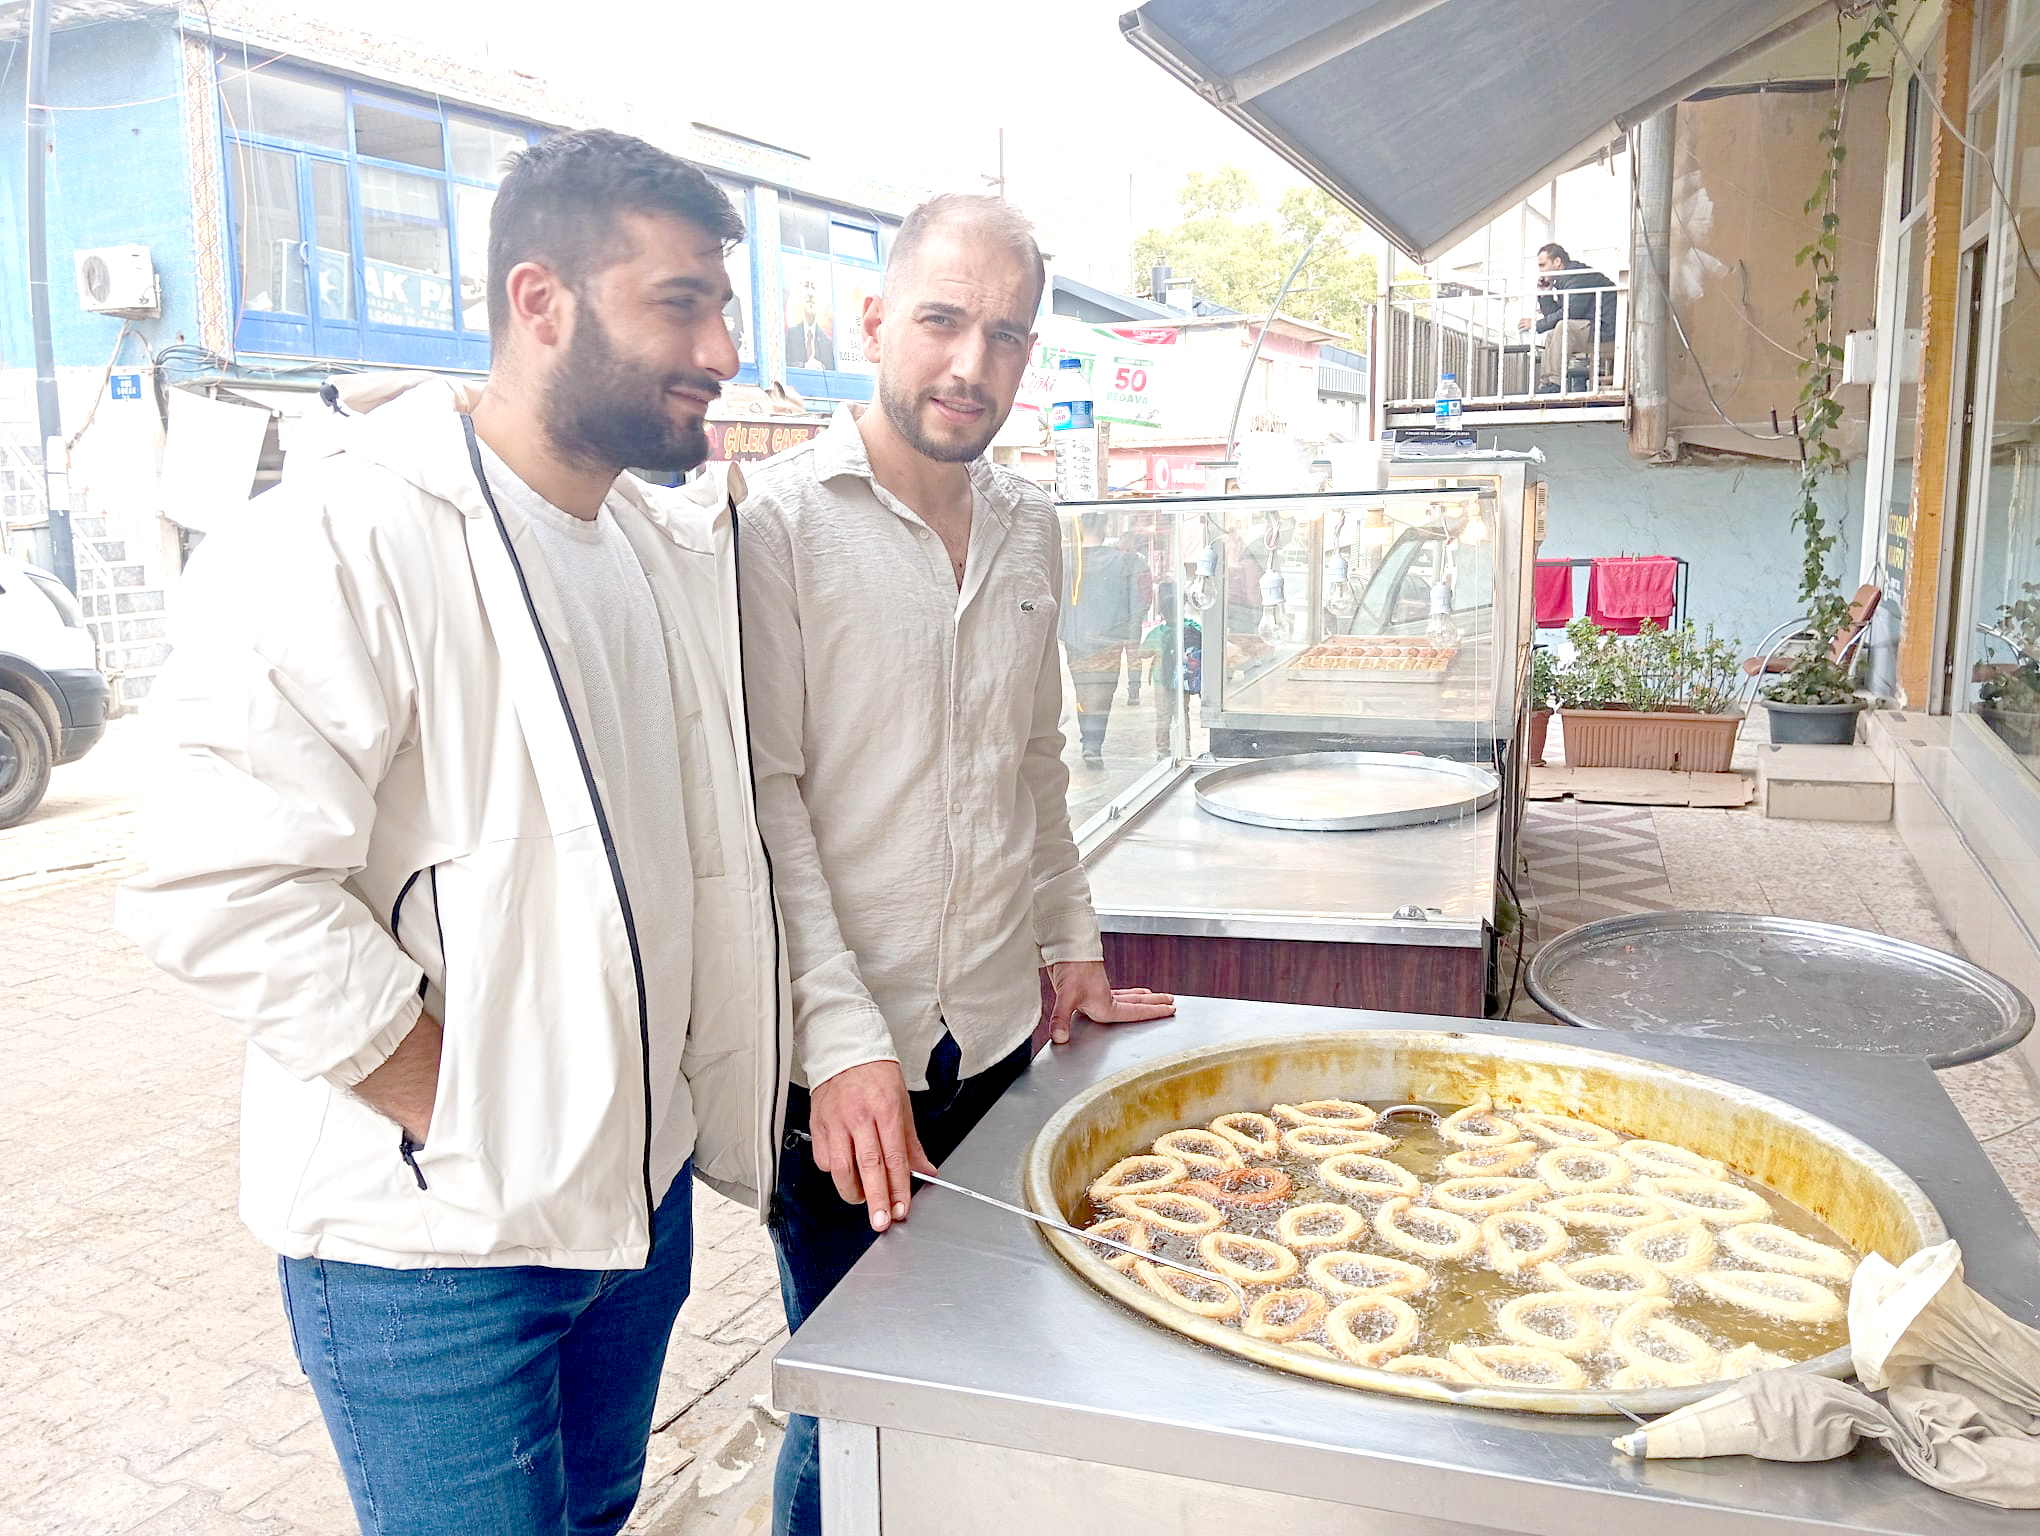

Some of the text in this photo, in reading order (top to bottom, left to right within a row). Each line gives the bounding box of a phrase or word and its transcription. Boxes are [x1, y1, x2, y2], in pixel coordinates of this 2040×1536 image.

[420, 279, 453, 312] PA
[1114, 368, 1147, 392] 50
[1106, 391, 1149, 405] BEDAVA
[723, 422, 769, 459] ÇİLEK
